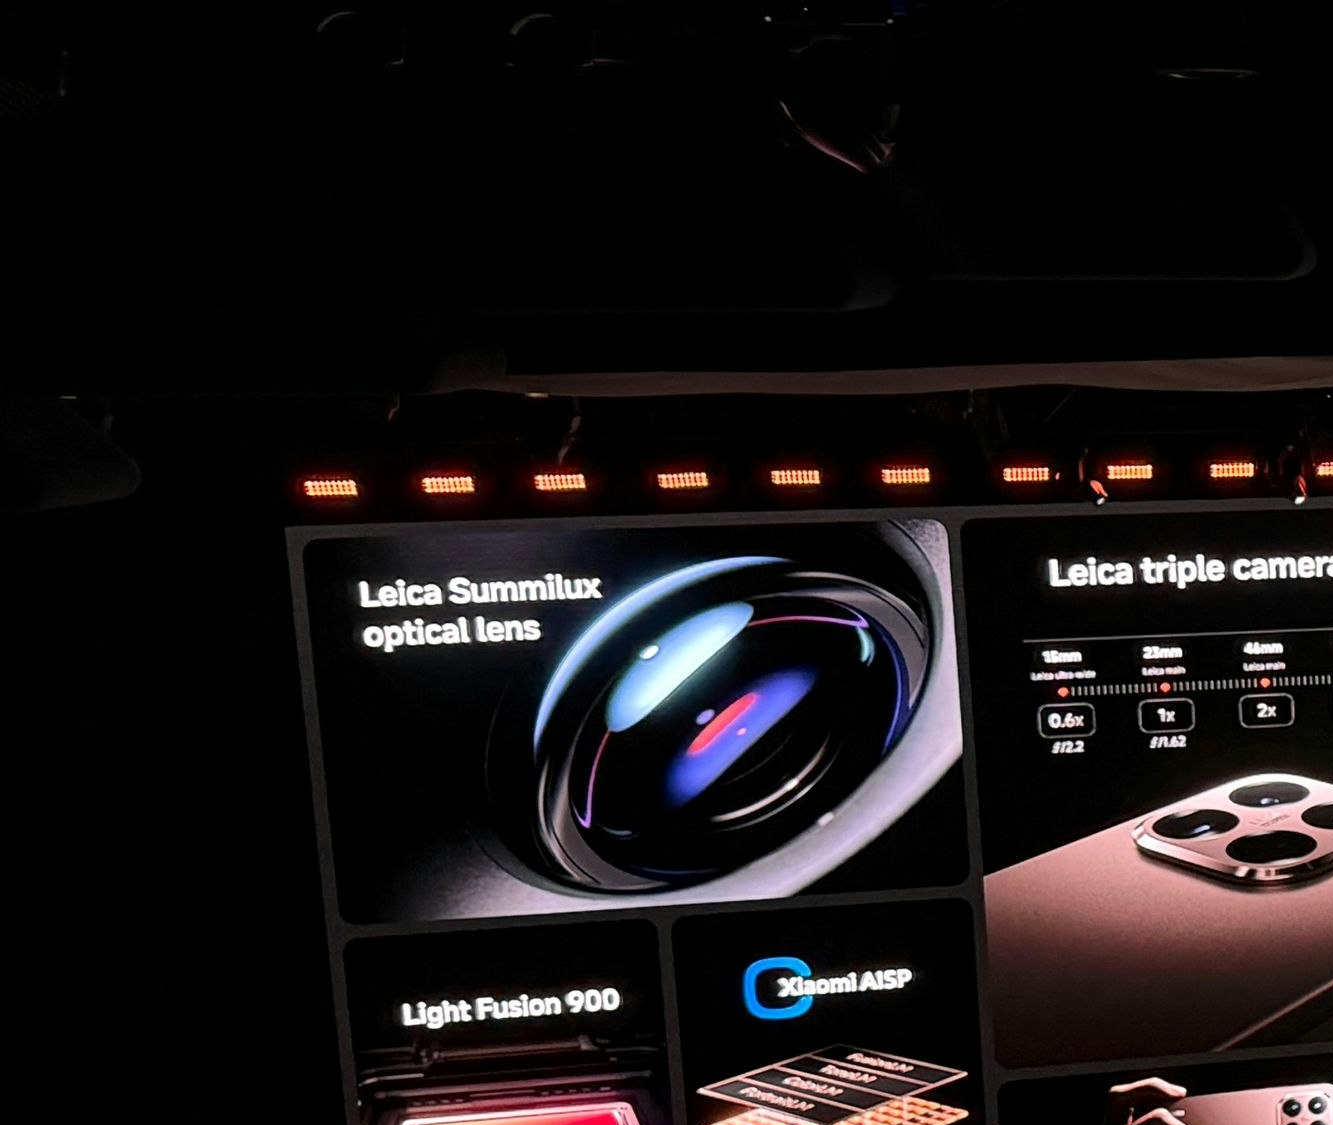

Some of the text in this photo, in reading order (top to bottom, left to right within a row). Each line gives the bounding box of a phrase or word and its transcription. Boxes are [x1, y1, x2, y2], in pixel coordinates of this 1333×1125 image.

[1048, 557, 1133, 587] Leica
[1140, 555, 1225, 589] triple
[359, 573, 602, 607] Leica Summilux
[363, 616, 541, 652] optical lens
[1142, 646, 1182, 659] 23mm
[1048, 713, 1084, 728] 0.6x
[1157, 708, 1176, 723] 1x
[1257, 703, 1276, 718] 2x
[777, 968, 913, 997] Xiaomi AISP
[401, 987, 621, 1029] Light Fusion 900
